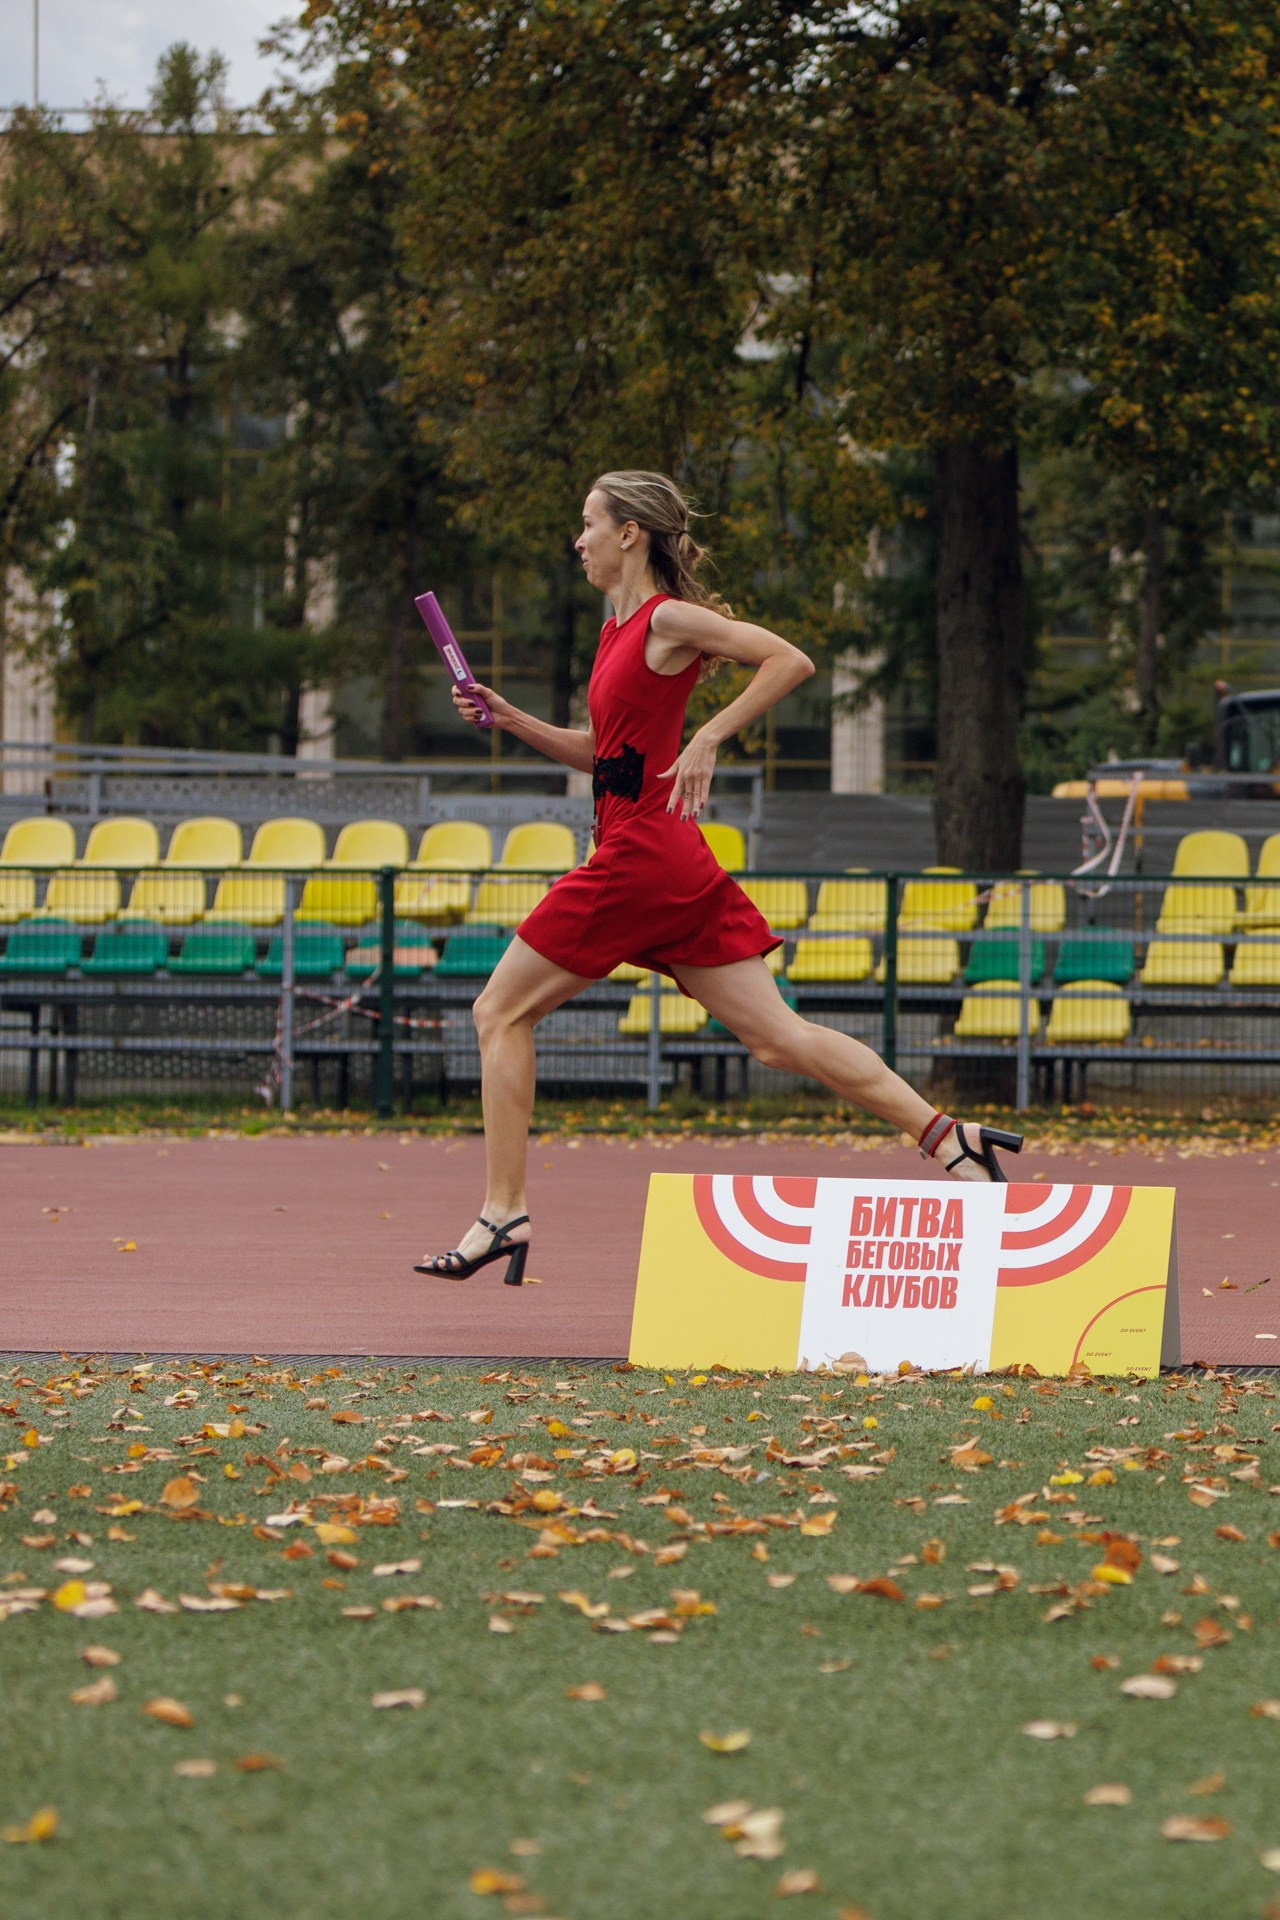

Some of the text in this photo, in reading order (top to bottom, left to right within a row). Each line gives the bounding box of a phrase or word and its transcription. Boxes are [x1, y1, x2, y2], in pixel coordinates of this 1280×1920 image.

[849, 1196, 964, 1239] БИТВА
[846, 1240, 962, 1271] БЕГОВЫХ
[842, 1274, 958, 1309] КЛУБОВ
